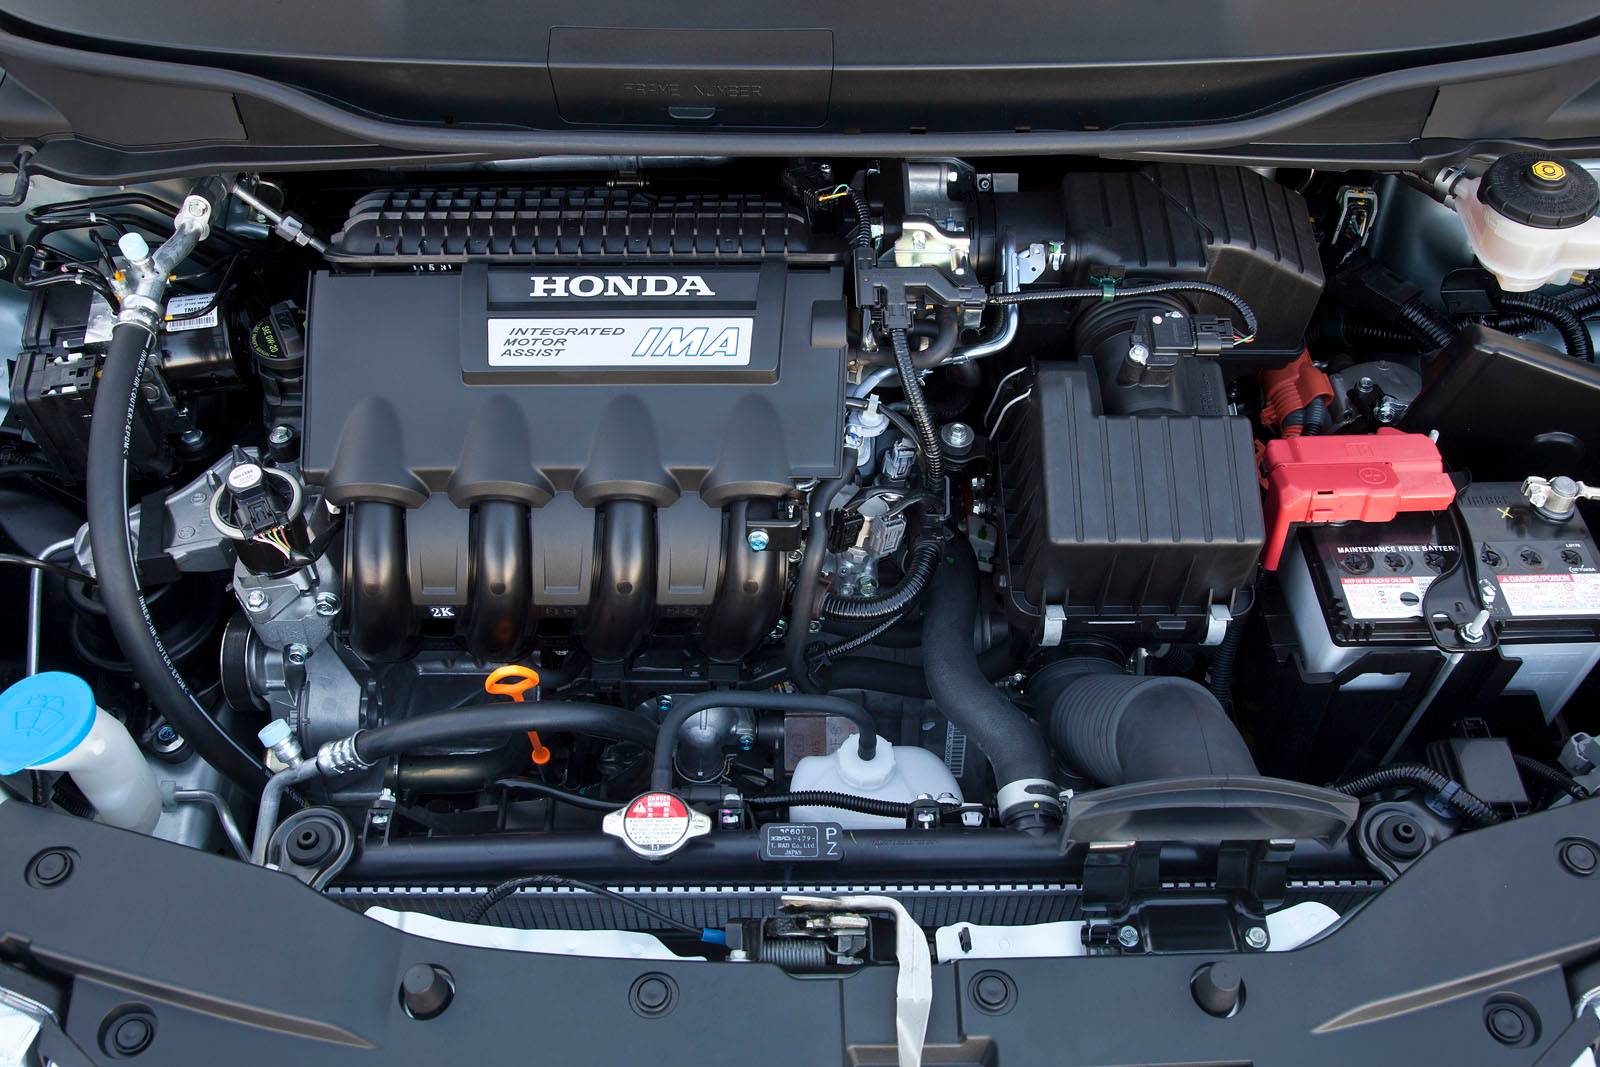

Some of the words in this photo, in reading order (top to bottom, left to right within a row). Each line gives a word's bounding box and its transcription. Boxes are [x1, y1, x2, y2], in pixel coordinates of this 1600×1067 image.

[624, 82, 681, 97] FRAME
[693, 84, 762, 97] NUMBER
[529, 275, 716, 297] HONDA
[509, 327, 625, 336] INTEGRATED
[503, 338, 568, 347] MOTOR
[631, 326, 740, 357] IMA
[500, 348, 566, 357] ASSIST
[1336, 545, 1397, 554] MAINTENANCE
[431, 607, 455, 618] 2K
[826, 827, 837, 841] P
[827, 842, 838, 855] Z
